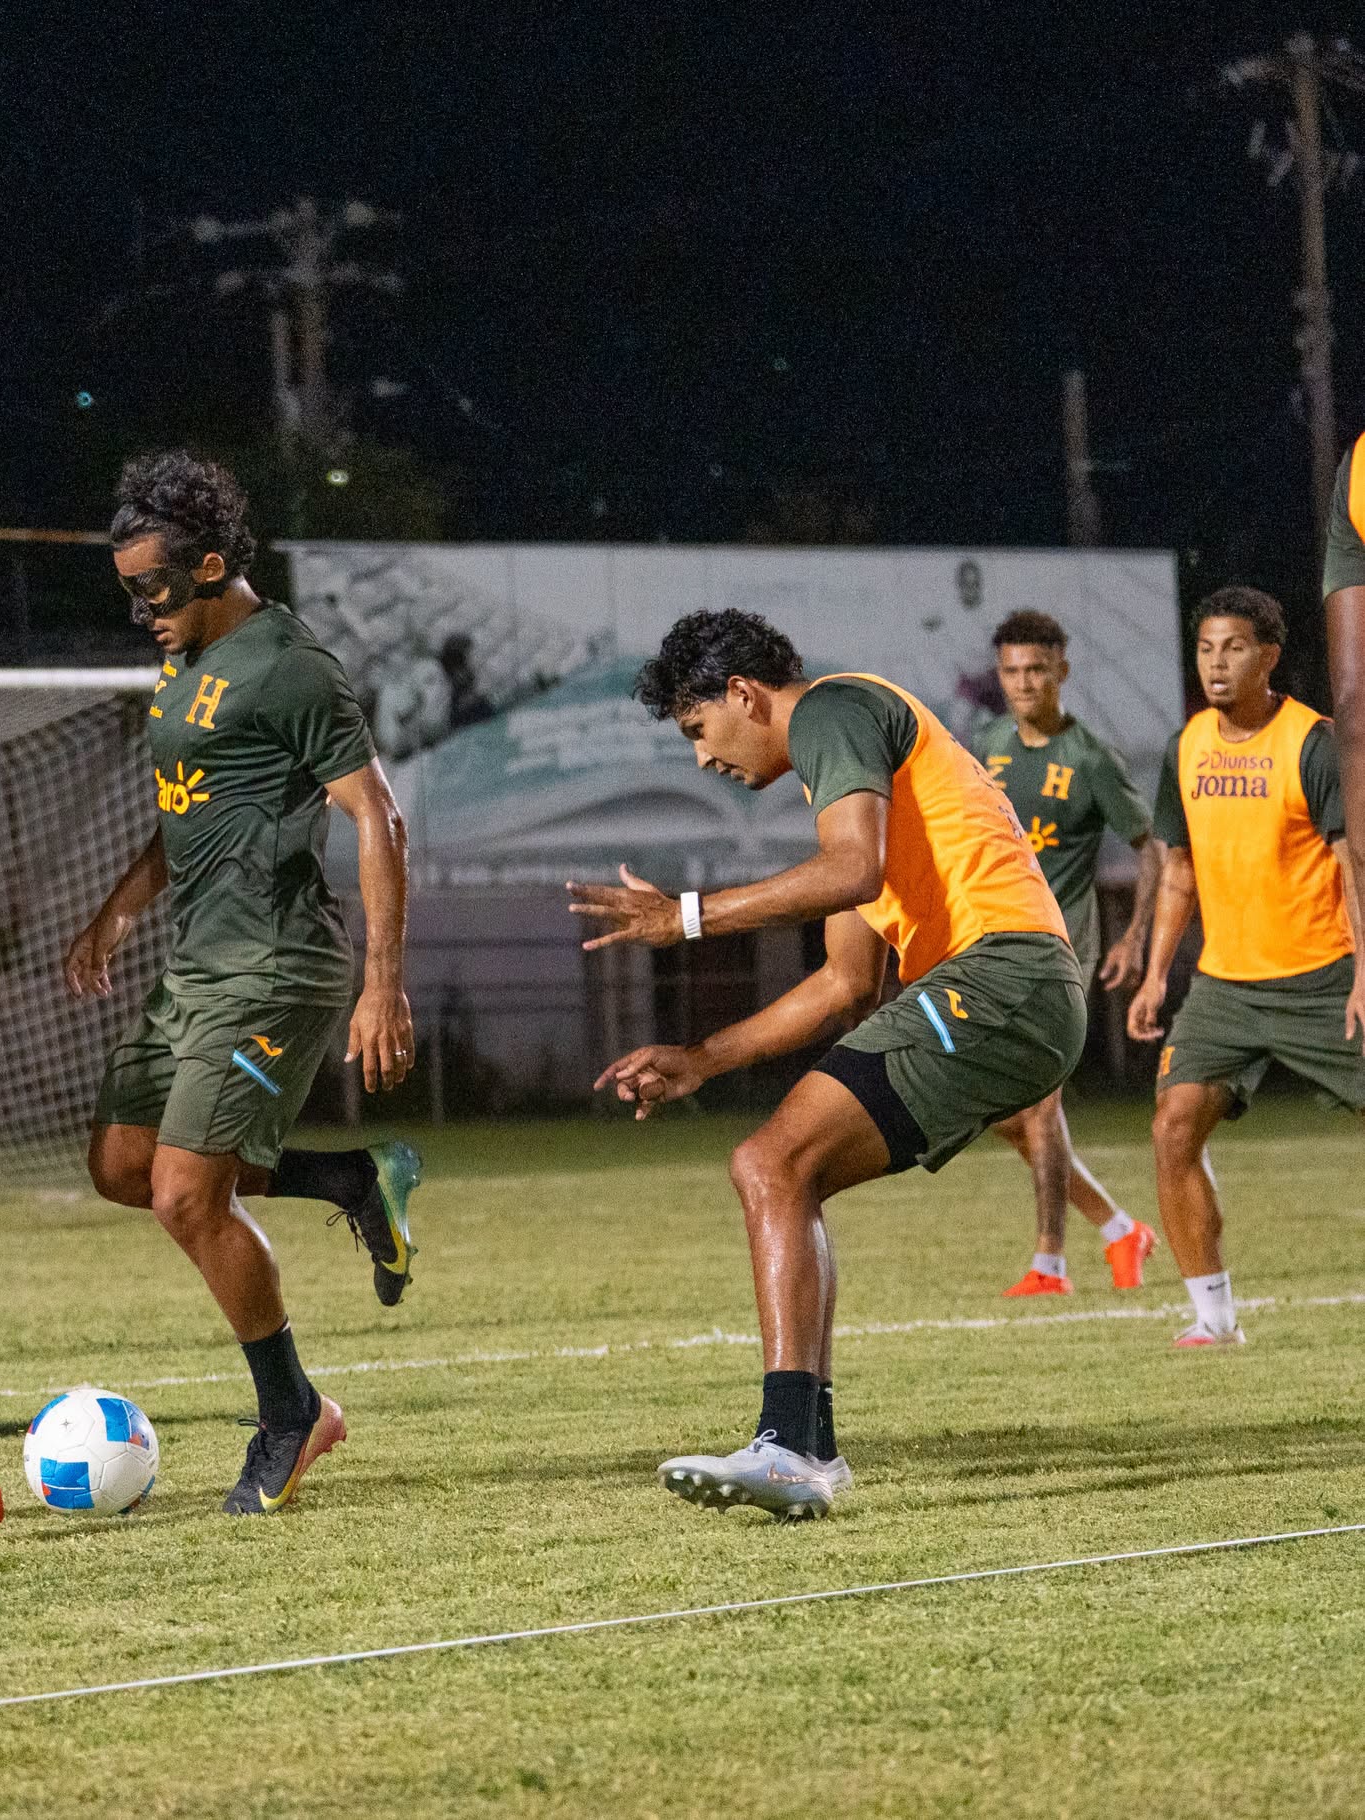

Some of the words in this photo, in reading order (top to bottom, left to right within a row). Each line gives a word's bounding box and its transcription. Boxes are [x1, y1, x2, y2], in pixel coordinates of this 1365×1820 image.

[185, 674, 230, 730] H
[1210, 751, 1274, 770] Diunsa
[1041, 762, 1075, 800] H
[1191, 775, 1269, 800] Joma
